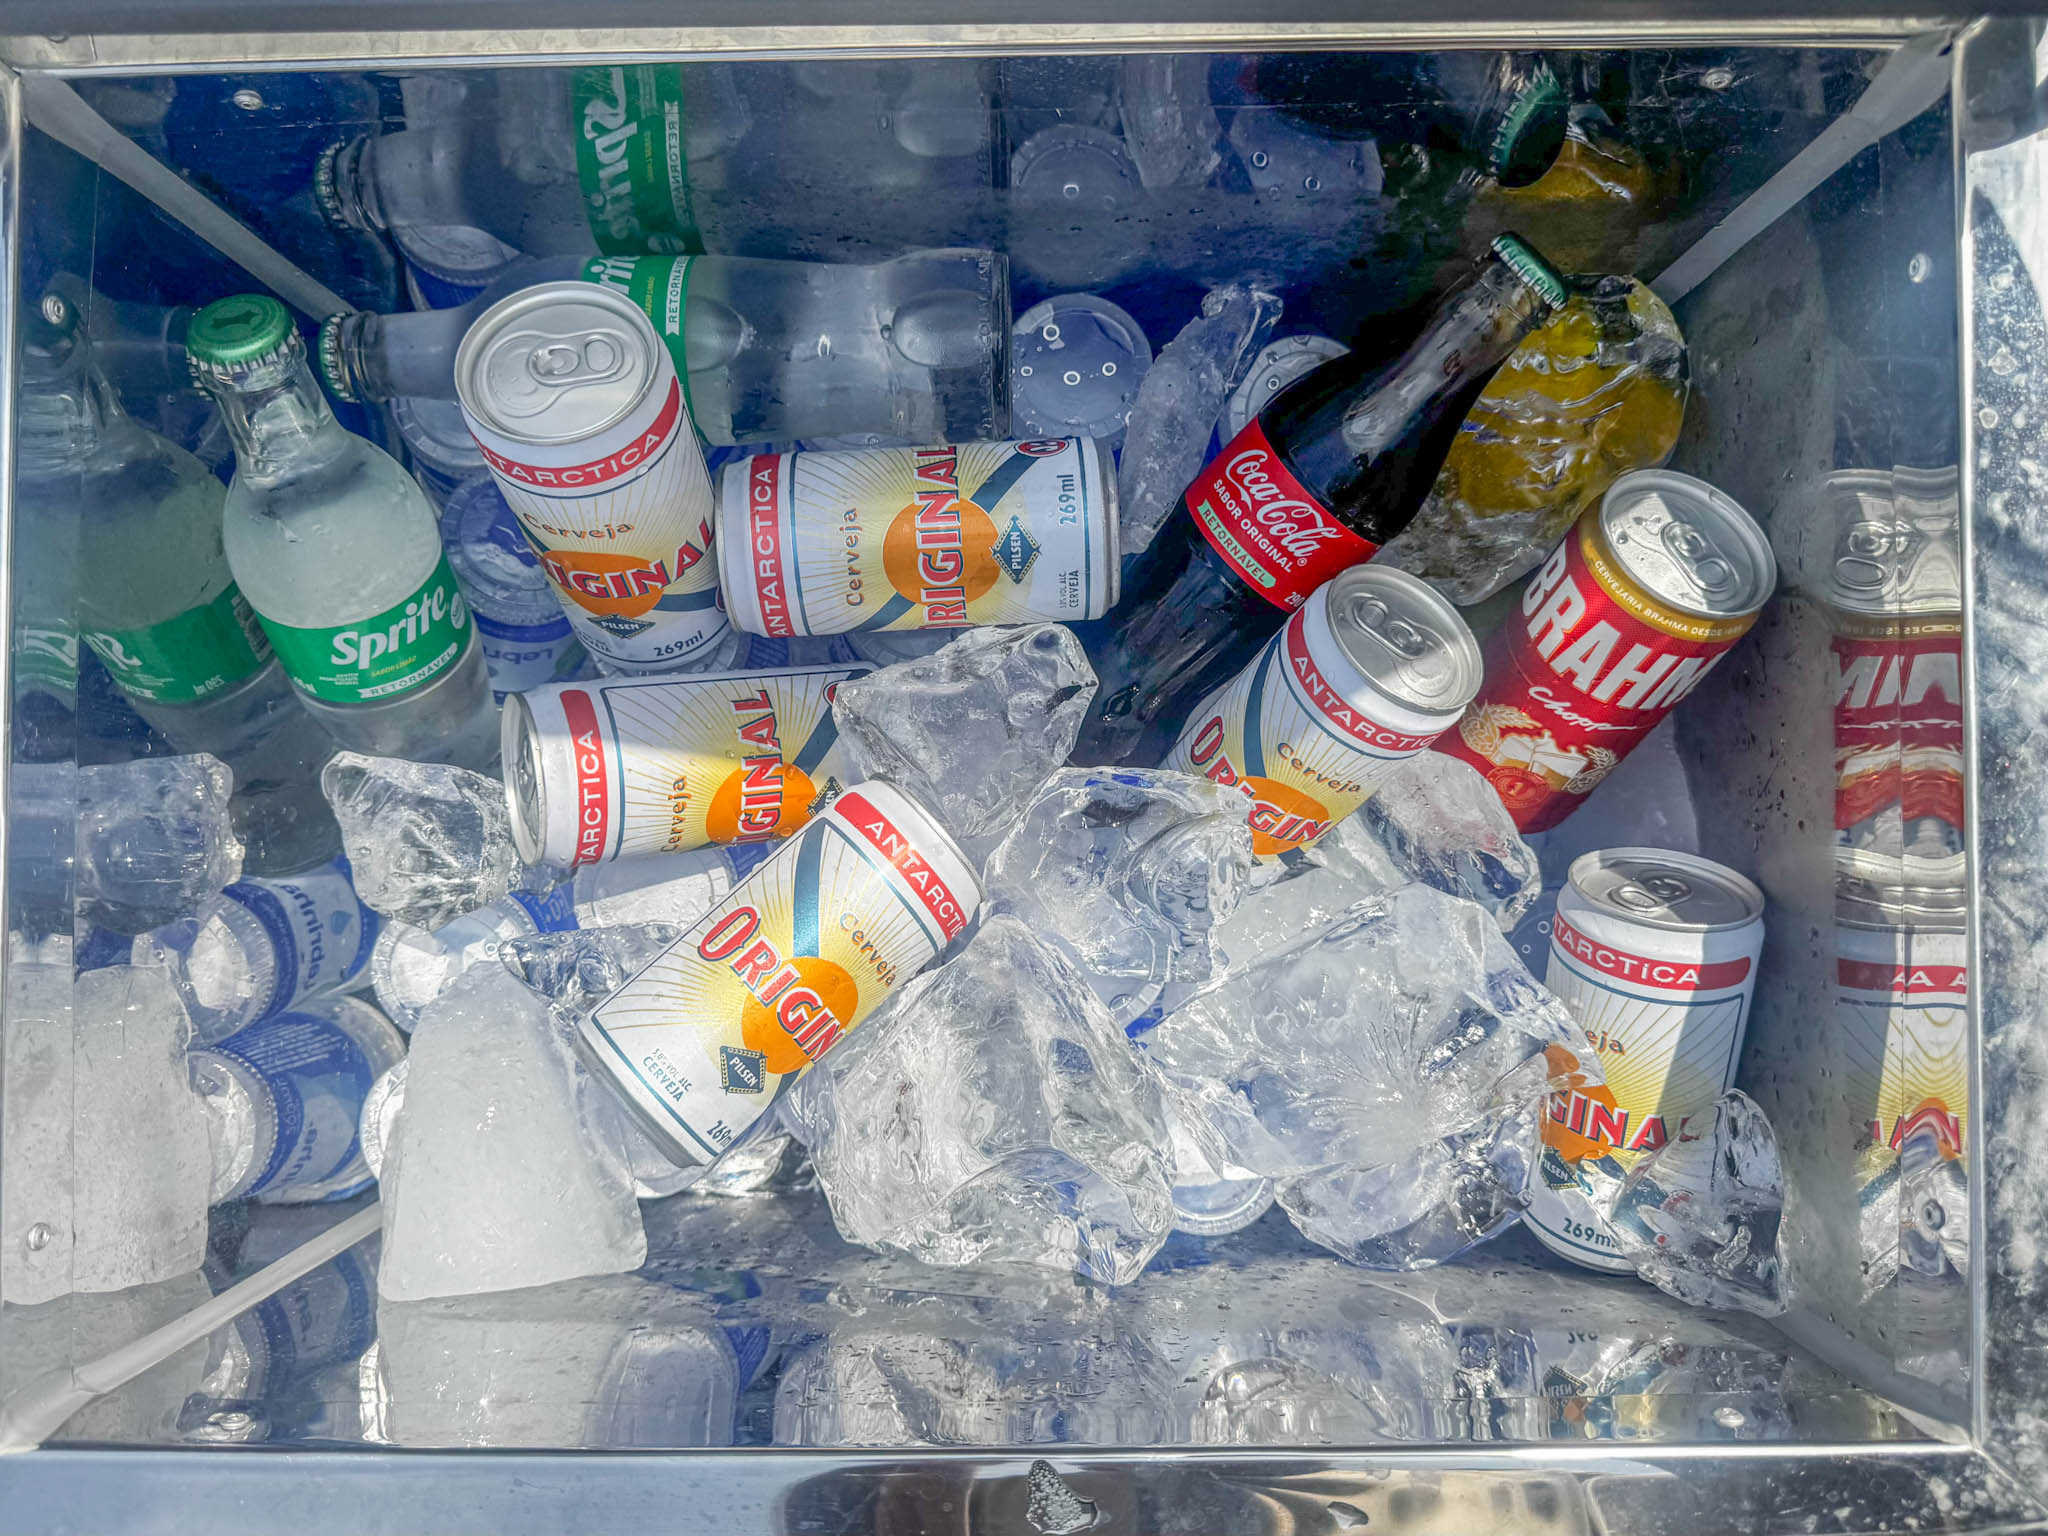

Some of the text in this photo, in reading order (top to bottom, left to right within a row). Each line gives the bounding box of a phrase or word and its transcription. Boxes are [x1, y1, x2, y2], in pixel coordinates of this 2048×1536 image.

[668, 256, 690, 323] RETORNAVE
[1056, 473, 1077, 525] 269ml
[1225, 449, 1343, 557] Coca-Cola
[522, 512, 635, 540] Cerveja
[753, 468, 794, 637] ANTARCTICA
[914, 445, 969, 629] RIGINAL
[1010, 531, 1022, 570] PILSEN
[1202, 507, 1266, 583] RETORNAVEL
[1213, 479, 1294, 574] SABOR ORIGINAL
[838, 506, 866, 607] Cerveja
[1068, 570, 1079, 609] CERVEJA
[1594, 559, 1643, 612] CERVEJARIA
[1643, 605, 1689, 633] BRAHMA
[331, 585, 448, 670] Sprite
[600, 620, 641, 631] PILSEN
[653, 629, 704, 657] 269ml
[370, 650, 454, 696] RETORNAVEL
[1528, 686, 1637, 731] Chopp
[1277, 742, 1362, 795] Cerveja
[660, 776, 692, 852] Cerveja
[839, 911, 896, 988] Cerveja
[1552, 915, 1700, 985] TARCTICA
[642, 1055, 685, 1102] CERVEJA
[729, 1056, 759, 1088] PILSEN
[706, 1119, 738, 1148] 269m
[1562, 1216, 1617, 1248] 269m
